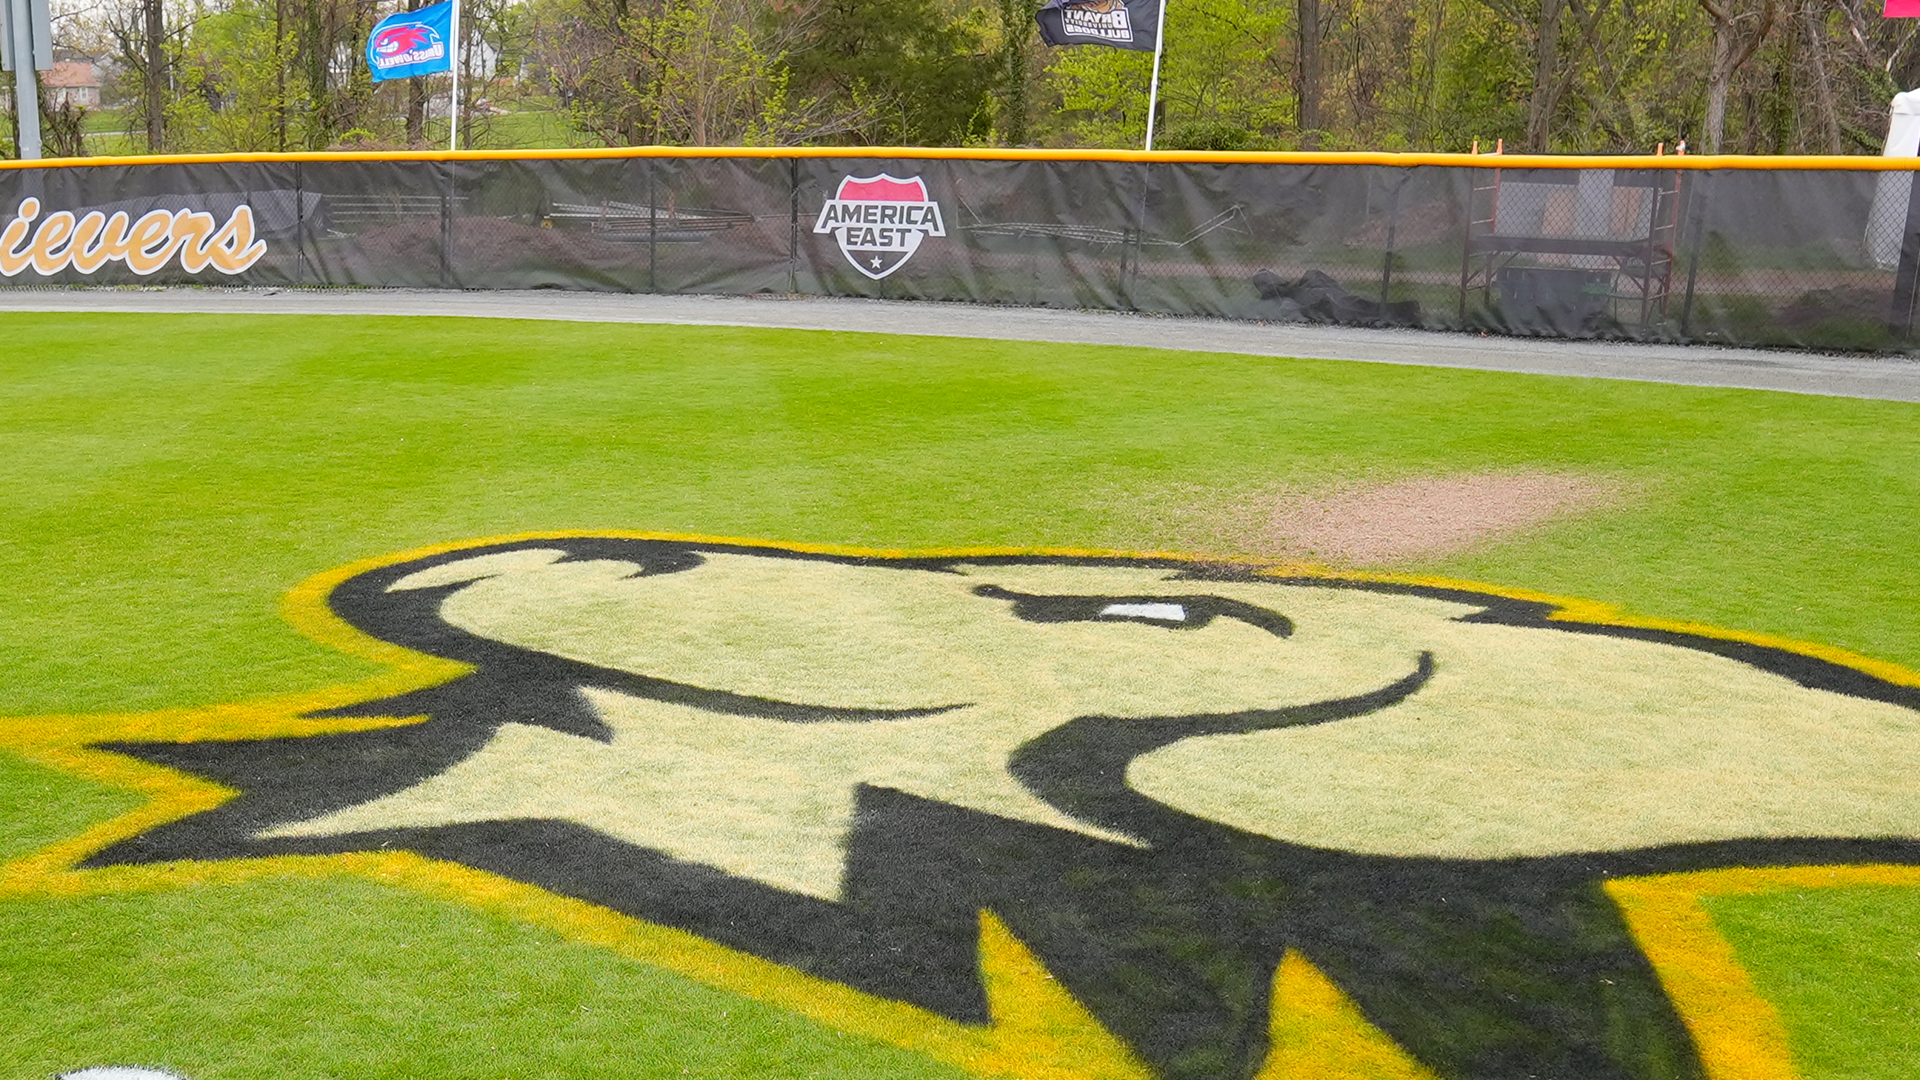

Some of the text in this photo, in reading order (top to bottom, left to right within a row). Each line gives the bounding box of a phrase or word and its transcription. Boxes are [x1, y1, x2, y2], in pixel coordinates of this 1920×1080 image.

[820, 204, 940, 232] AMERICA
[0, 197, 267, 276] ievers
[846, 227, 912, 247] EAST
